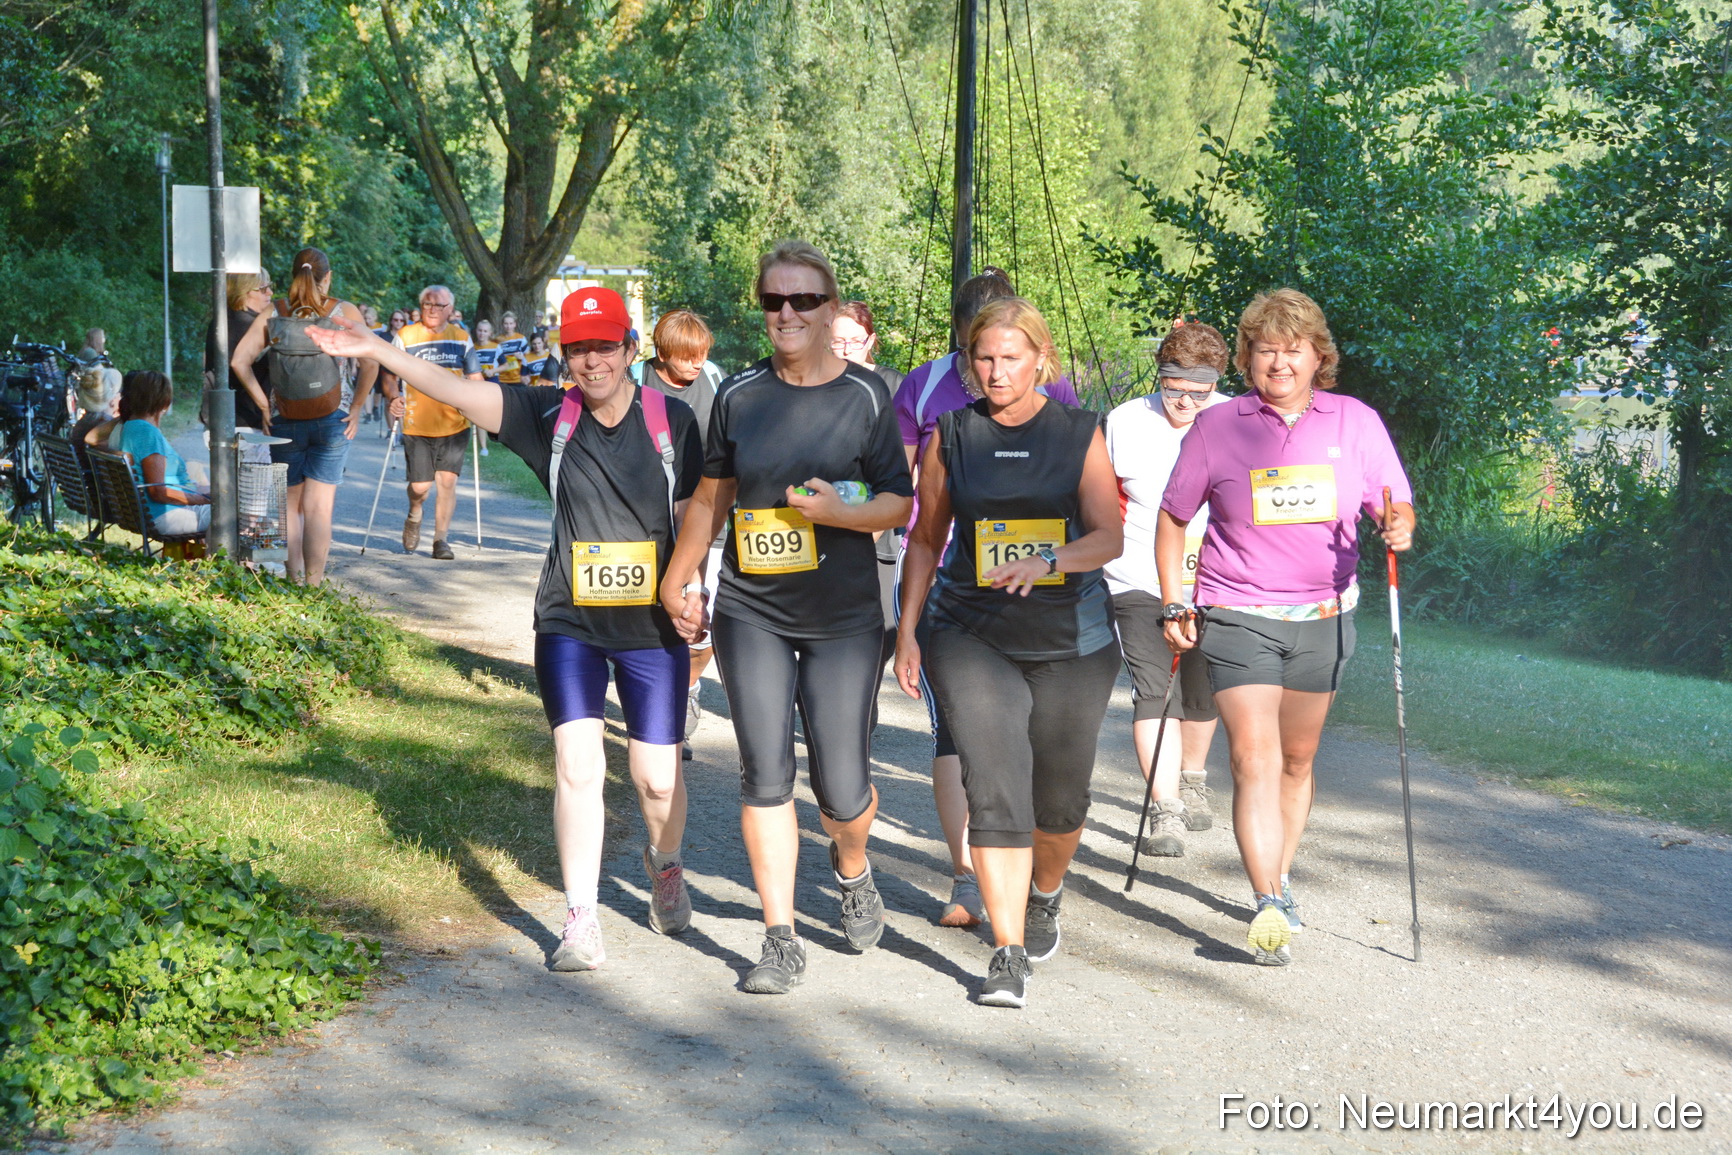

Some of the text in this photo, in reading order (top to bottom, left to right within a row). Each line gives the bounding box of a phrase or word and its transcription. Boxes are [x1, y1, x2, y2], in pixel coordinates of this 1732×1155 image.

[422, 352, 458, 360] Fischer
[743, 530, 802, 555] 1699
[584, 565, 645, 587] 1659
